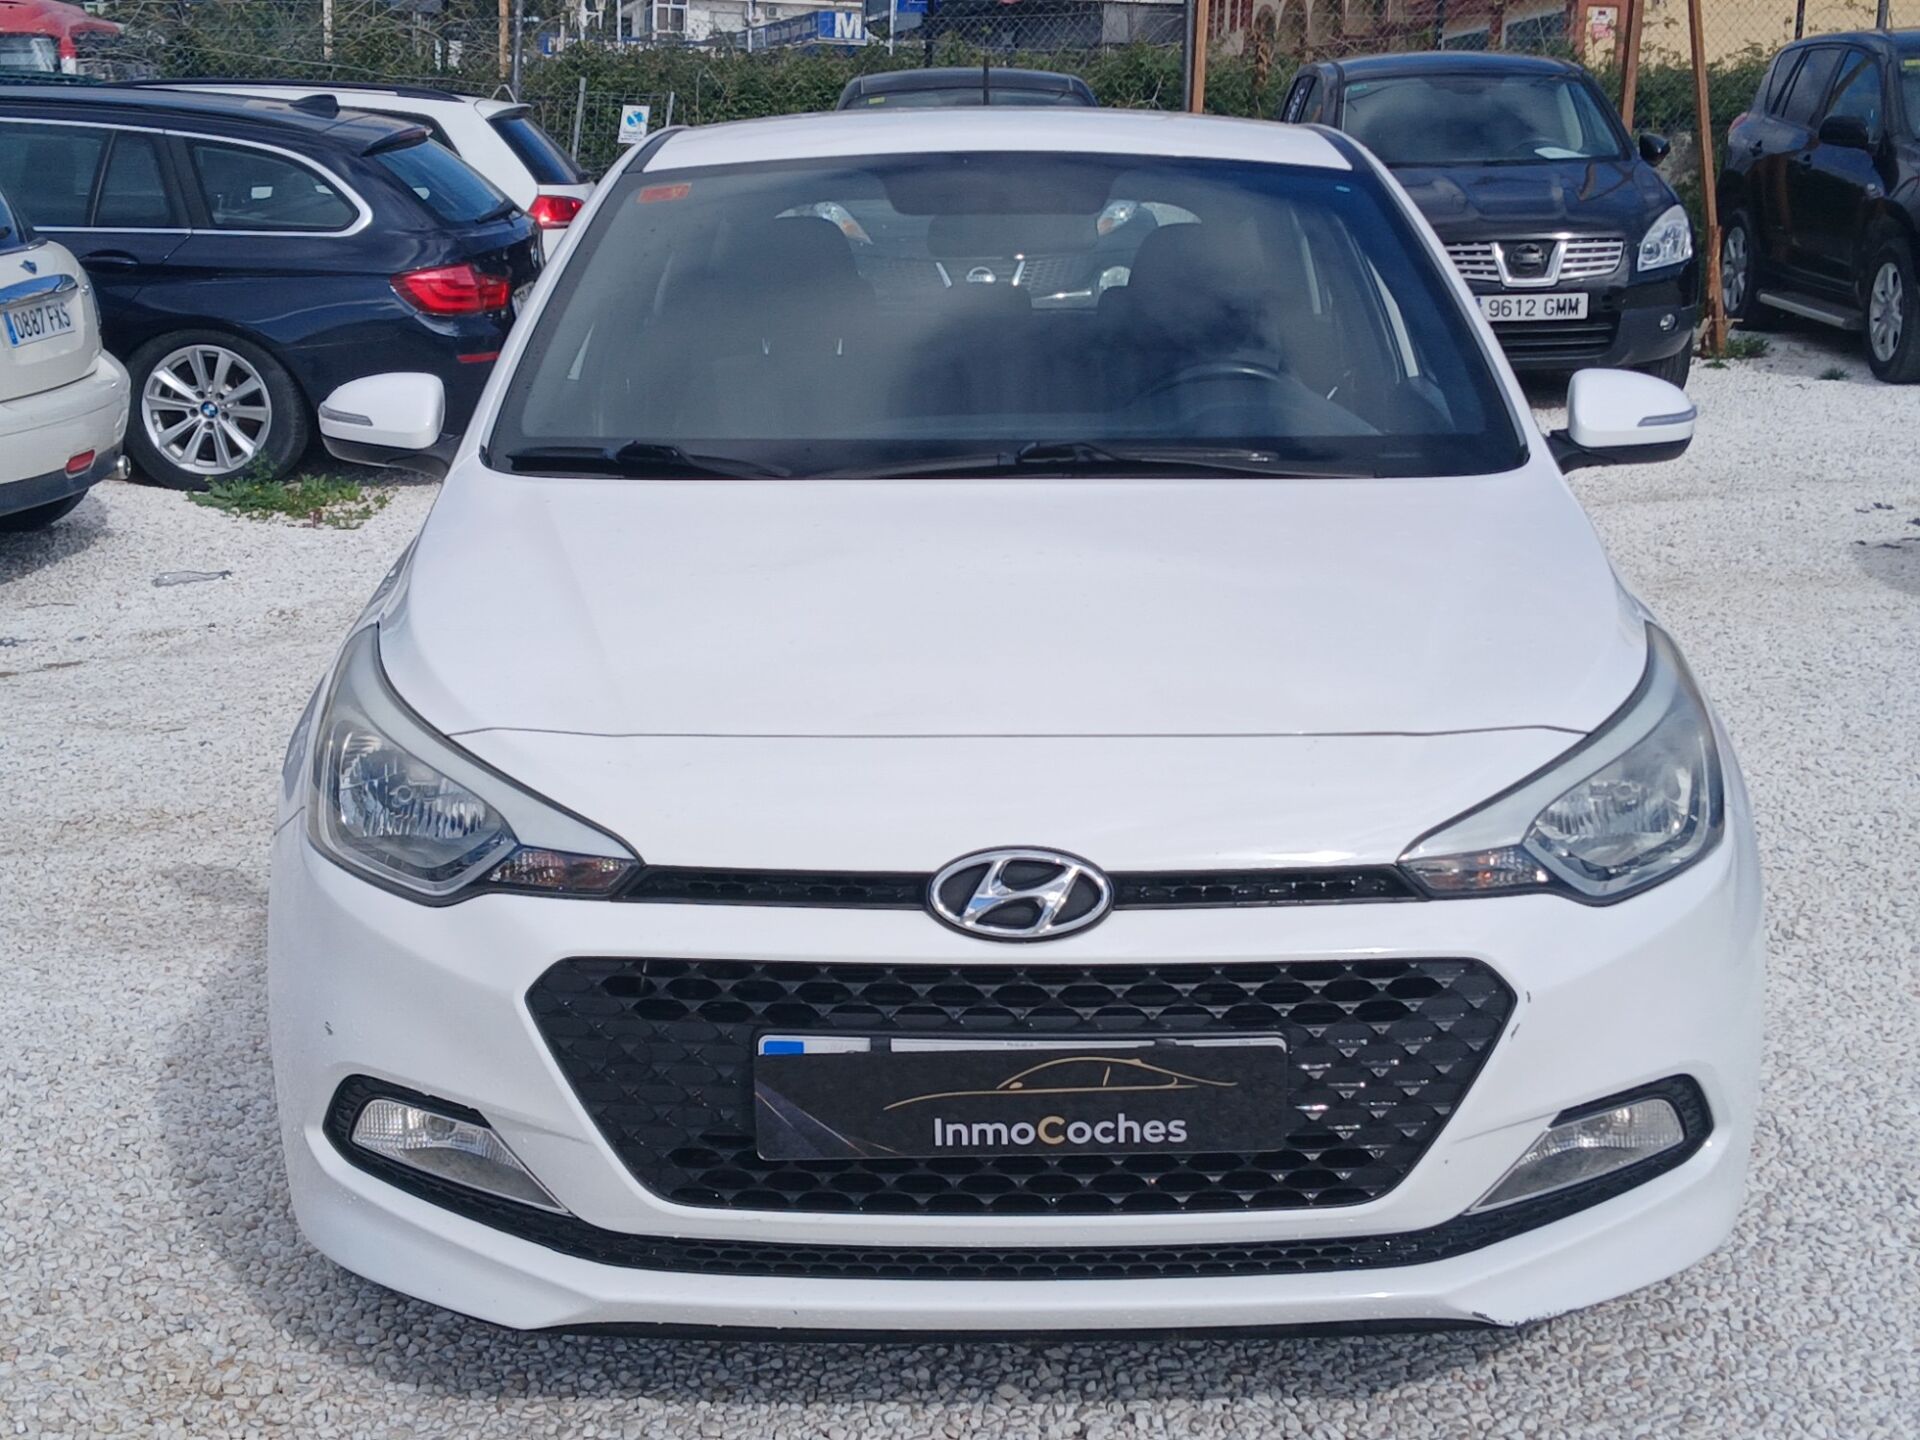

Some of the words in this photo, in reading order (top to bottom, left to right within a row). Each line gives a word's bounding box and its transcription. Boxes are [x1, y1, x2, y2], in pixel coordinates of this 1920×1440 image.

[834, 12, 862, 39] M
[13, 307, 45, 339] 0887
[45, 302, 71, 331] FXS
[1488, 299, 1537, 317] 9612
[1543, 297, 1580, 316] GMM
[934, 1113, 1188, 1146] InmoCoches
